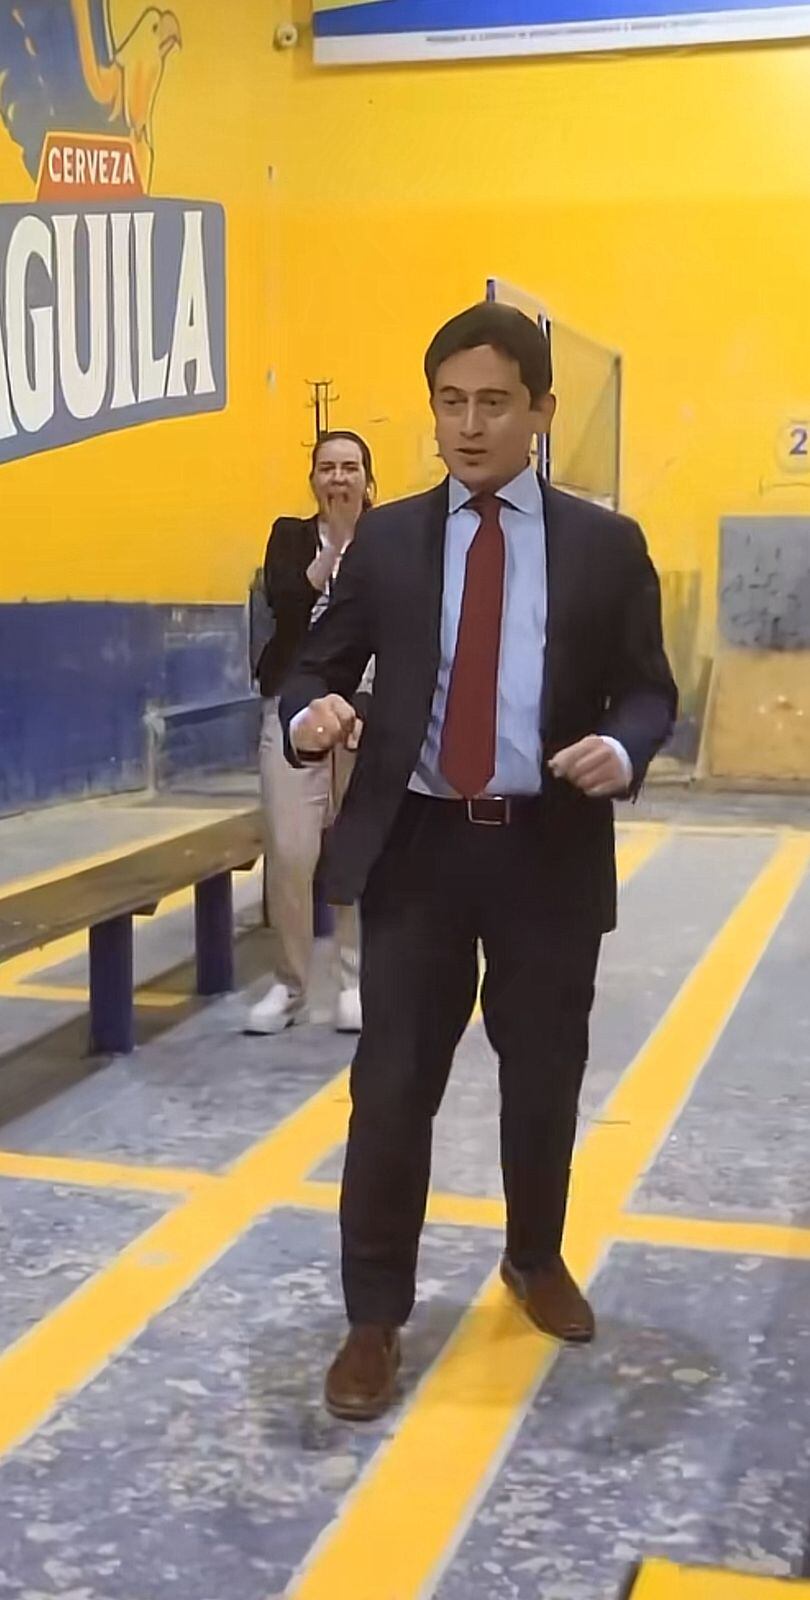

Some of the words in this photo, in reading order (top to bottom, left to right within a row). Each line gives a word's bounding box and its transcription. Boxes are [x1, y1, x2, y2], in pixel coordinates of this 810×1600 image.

[48, 147, 135, 185] CERVEZA
[0, 211, 216, 440] GUILA
[789, 427, 808, 456] 2
